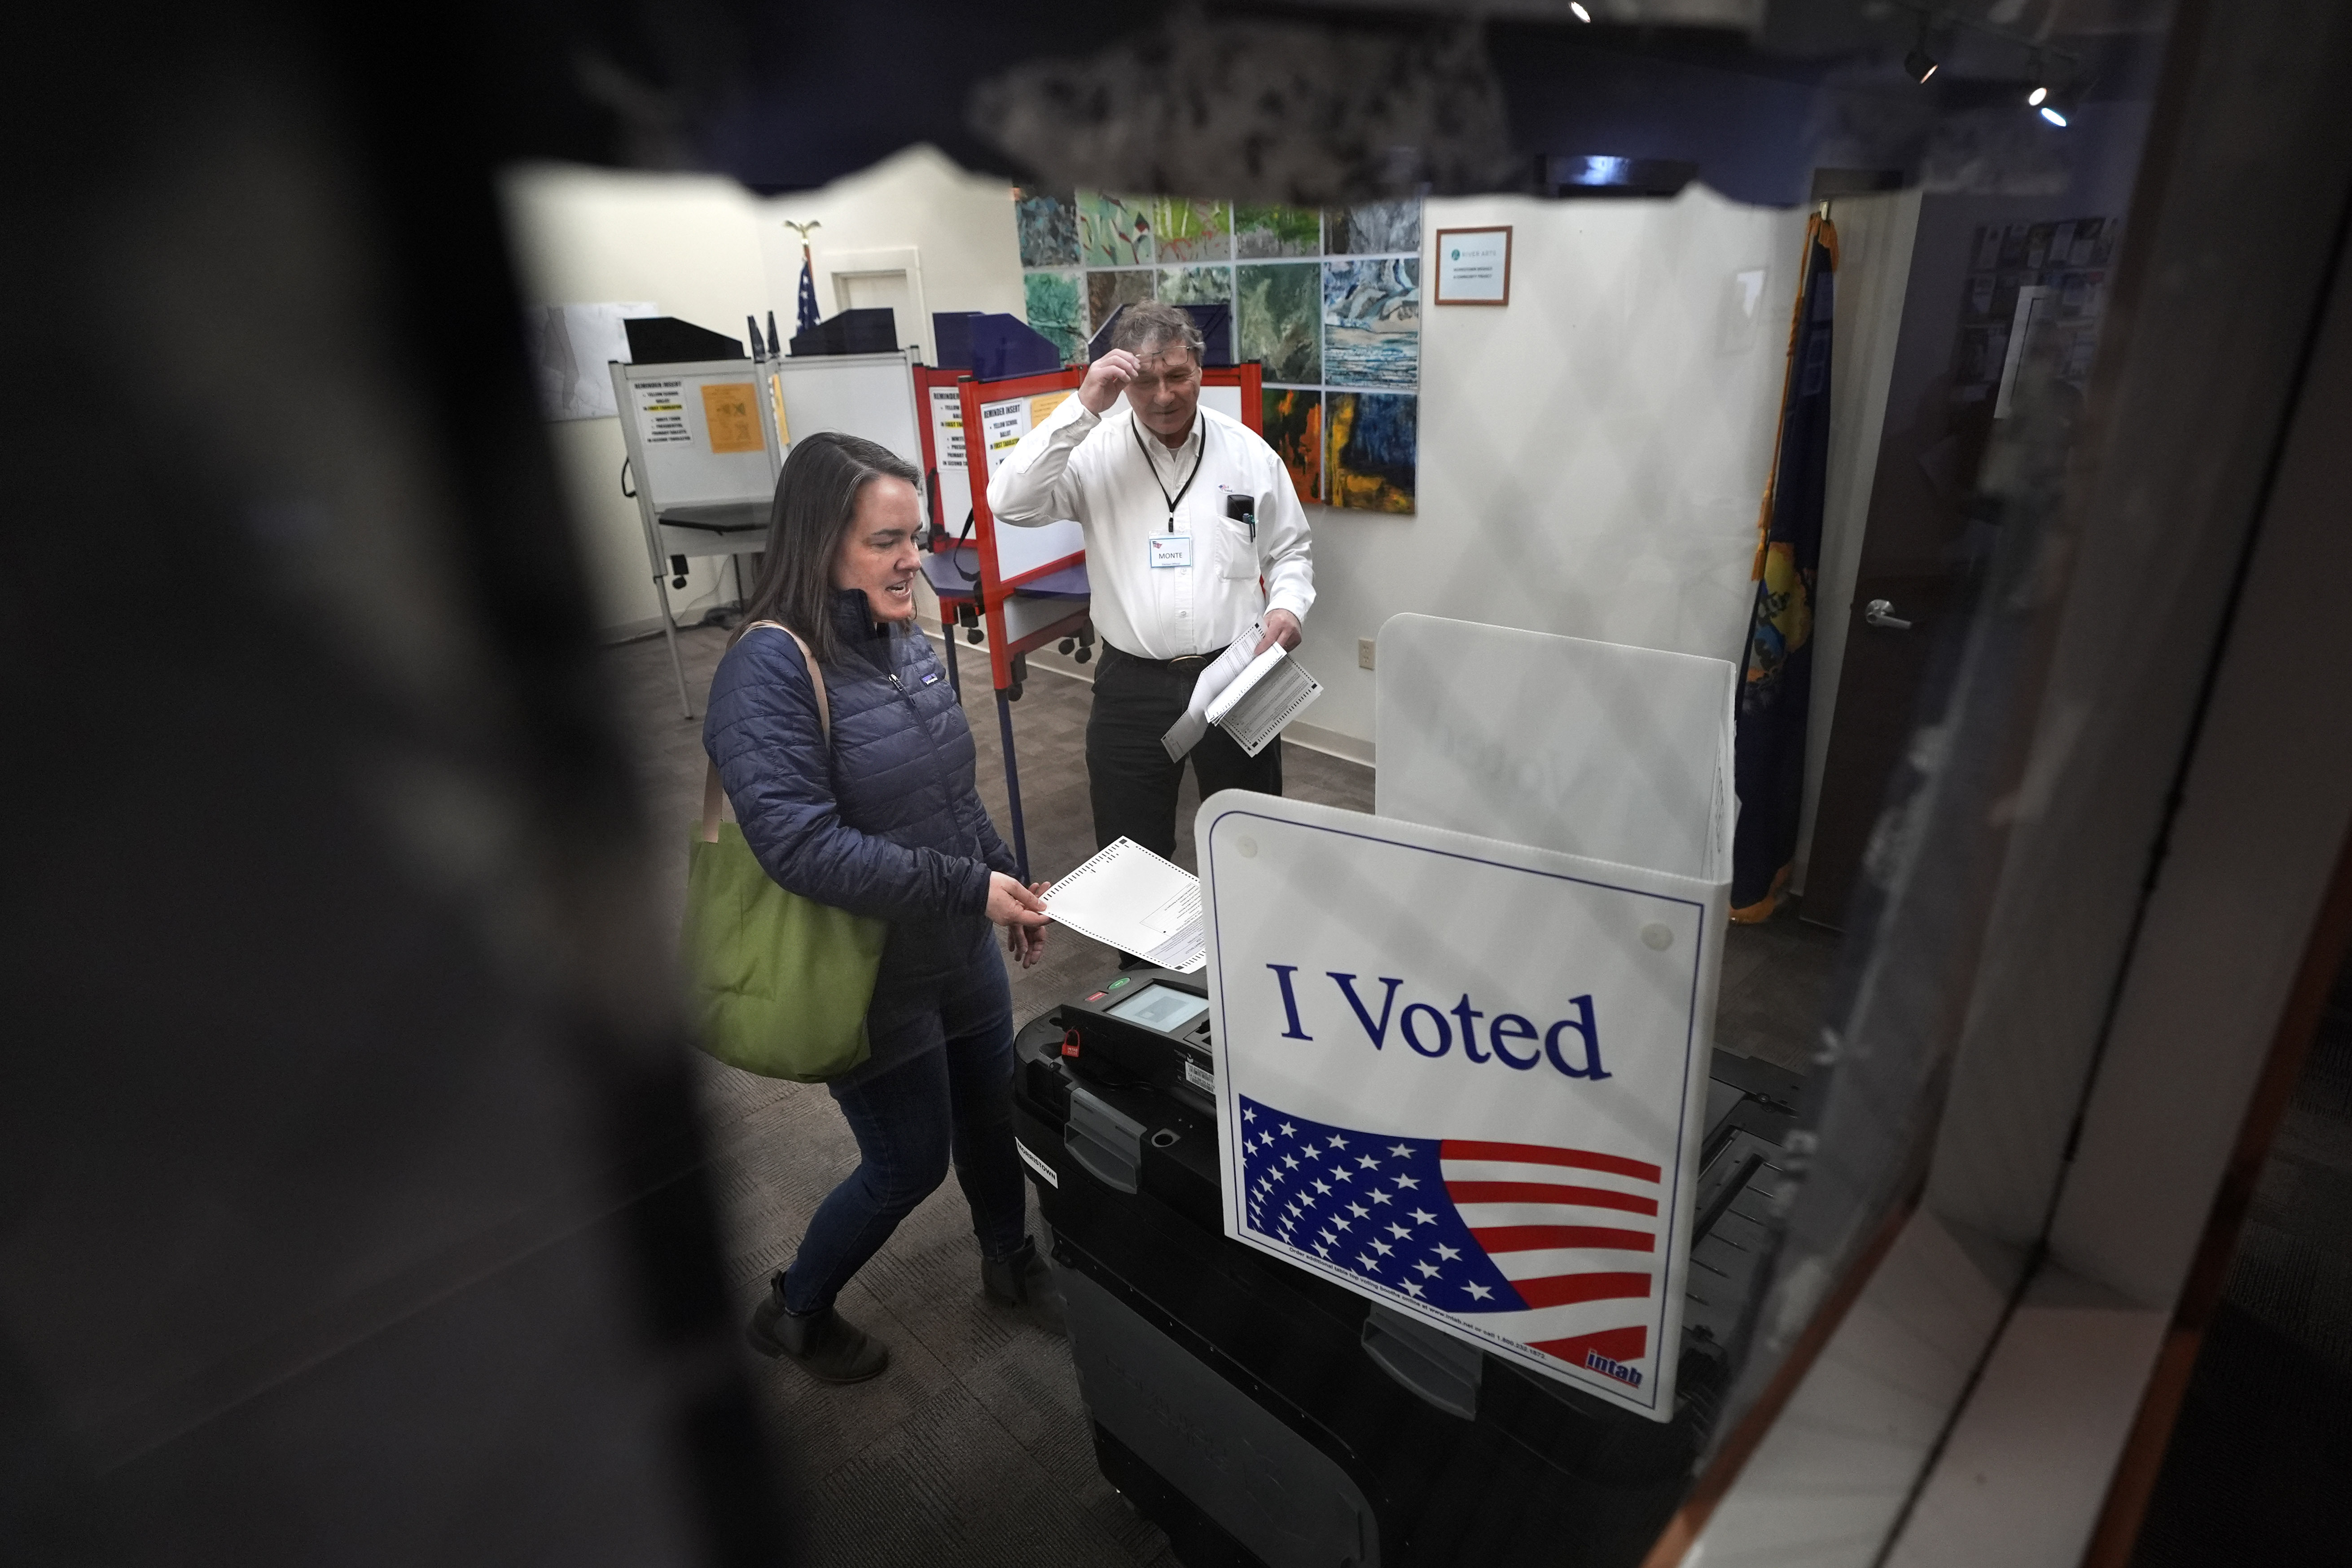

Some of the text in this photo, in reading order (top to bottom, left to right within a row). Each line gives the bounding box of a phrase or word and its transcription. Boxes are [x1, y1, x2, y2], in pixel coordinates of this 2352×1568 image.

[984, 404, 1020, 418] REMINDER INSERT
[1266, 963, 1612, 1081] I Voted
[1017, 1142, 1055, 1180] MORRISTOWN
[1289, 1247, 1304, 1257] Order
[1307, 1255, 1333, 1269] additional
[1334, 1267, 1348, 1275] table
[1349, 1273, 1359, 1281] top
[1360, 1278, 1378, 1289] voting
[1380, 1286, 1400, 1298] booths
[1483, 1329, 1495, 1338] call
[1587, 1348, 1643, 1386] intab
